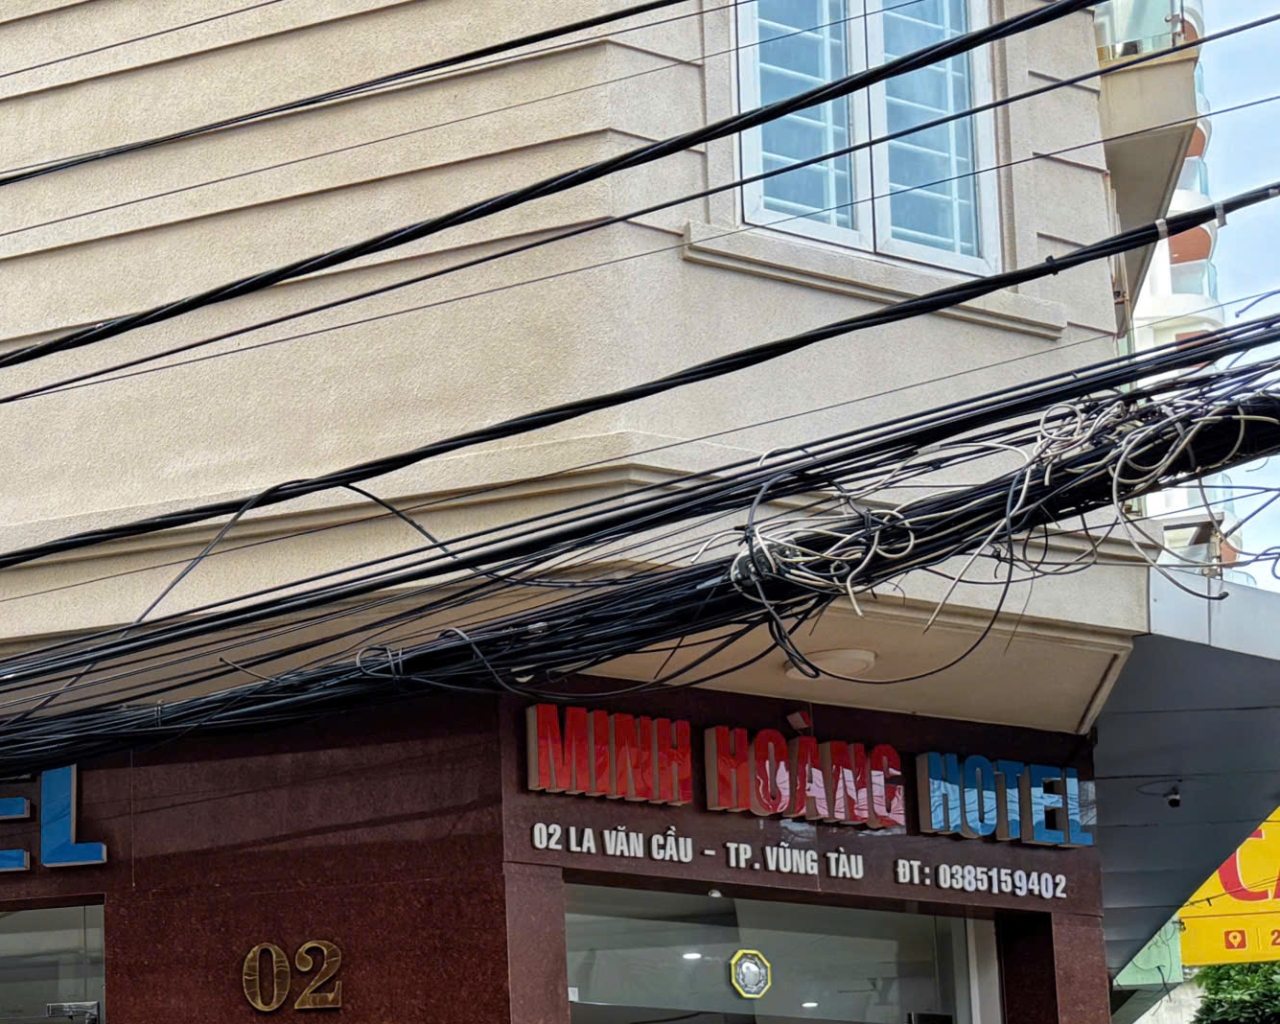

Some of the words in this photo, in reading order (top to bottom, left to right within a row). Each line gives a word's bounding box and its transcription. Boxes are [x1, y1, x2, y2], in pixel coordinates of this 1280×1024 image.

[526, 703, 694, 806] MINH
[705, 711, 907, 829] HOÀNG
[916, 752, 1094, 848] HOTEL
[533, 823, 563, 851] 02
[570, 826, 597, 853] LA
[604, 826, 644, 858] VĂN
[652, 826, 693, 862] CẦU
[766, 842, 819, 875] VŨNG
[827, 847, 864, 879] TÀU
[938, 863, 1068, 900] 0385159402
[242, 940, 343, 1012] 02
